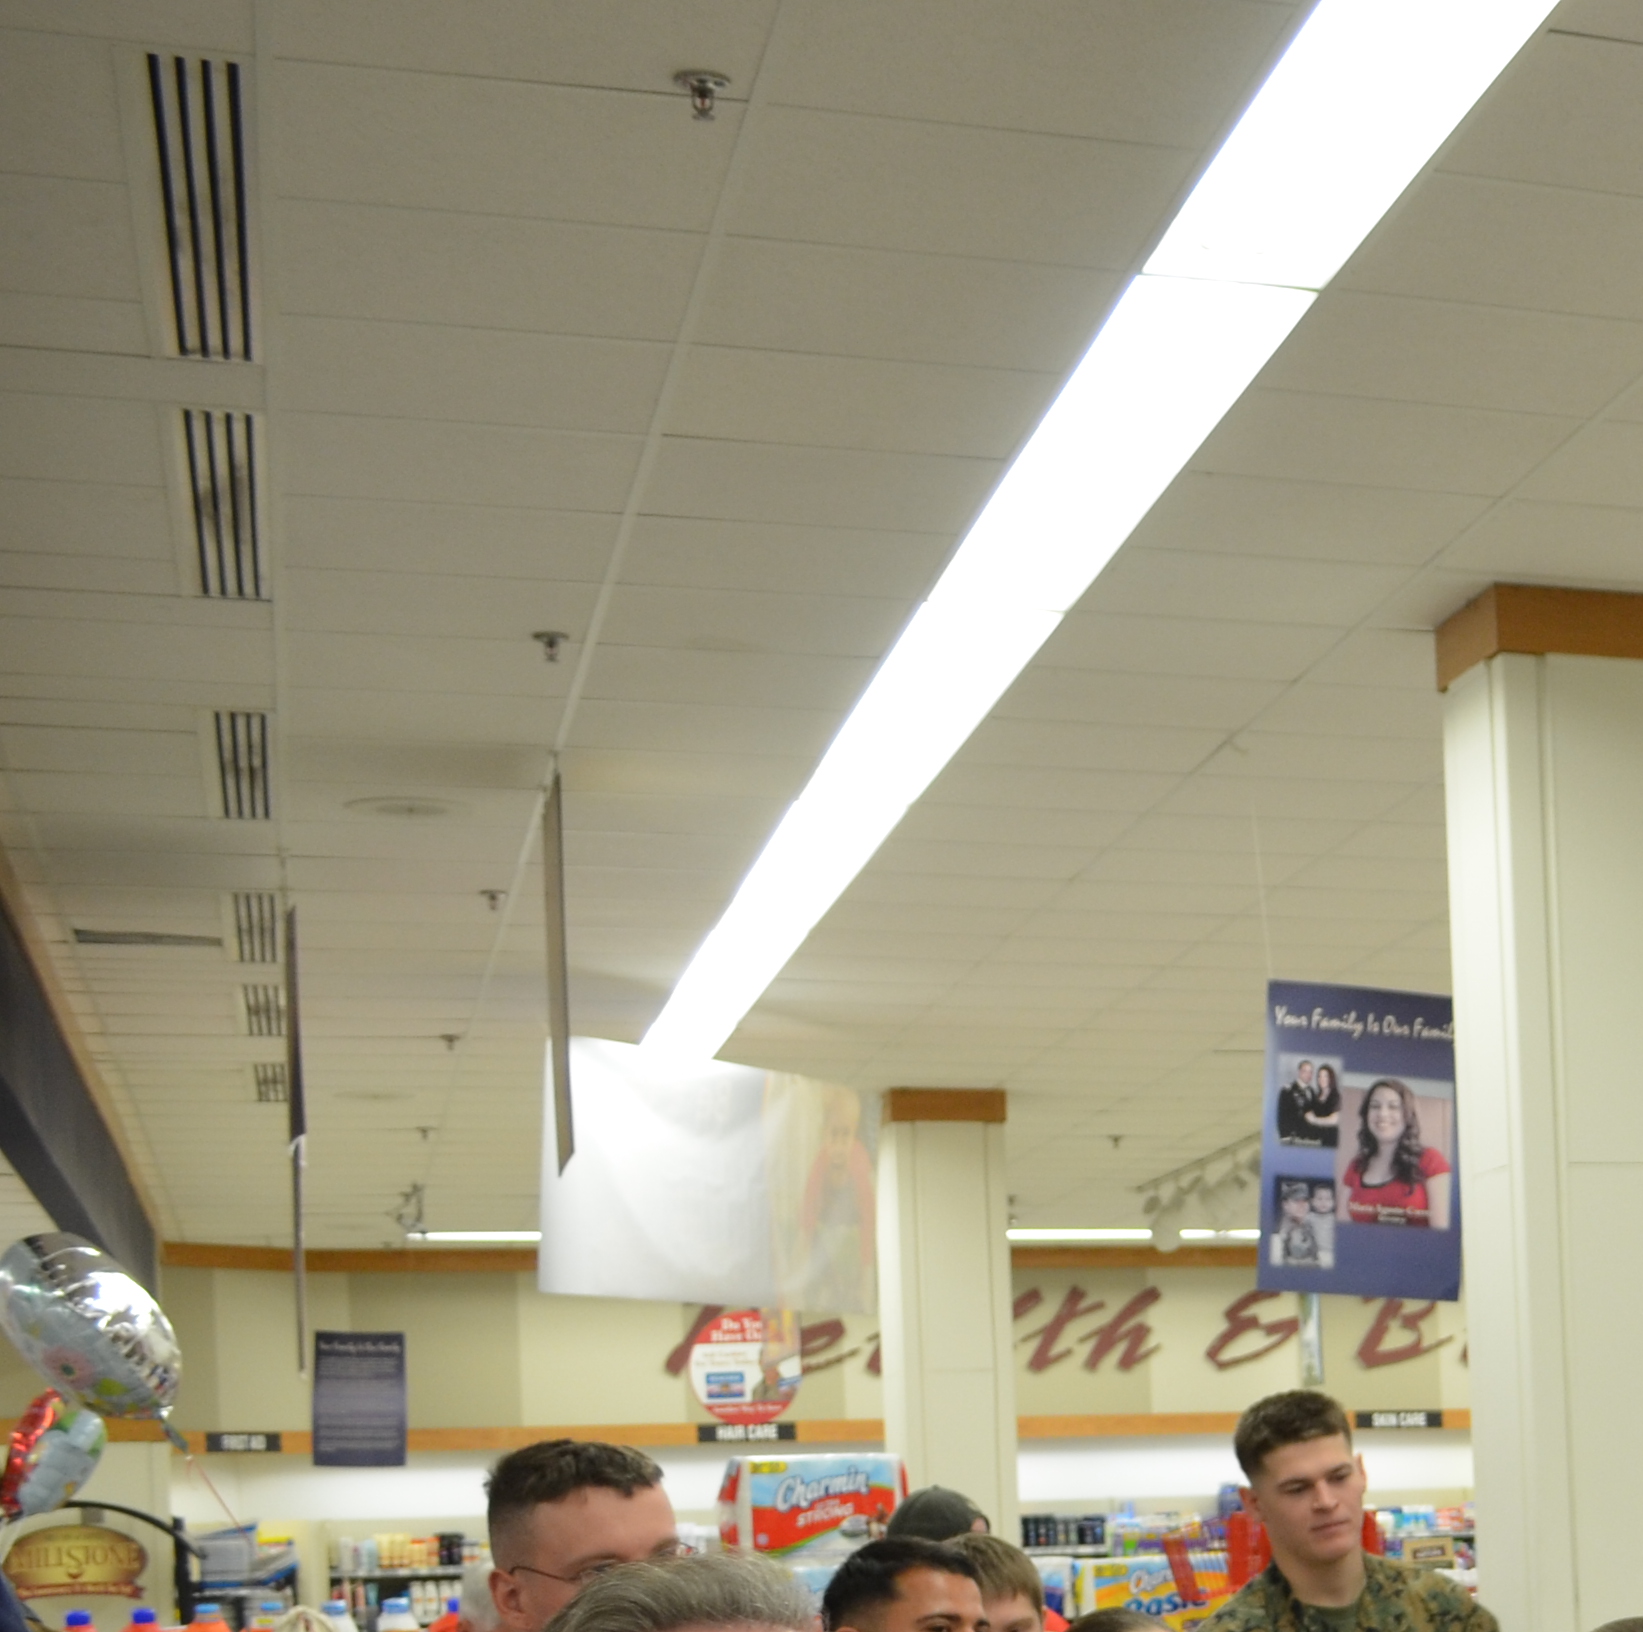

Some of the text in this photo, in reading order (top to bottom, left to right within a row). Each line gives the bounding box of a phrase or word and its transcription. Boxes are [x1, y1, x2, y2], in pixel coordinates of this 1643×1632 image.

[1275, 1005, 1454, 1040] Your Family Is Our Famil
[716, 1424, 778, 1441] HAIR CARE
[1399, 1412, 1427, 1427] CARE
[776, 1466, 870, 1512] Charmin
